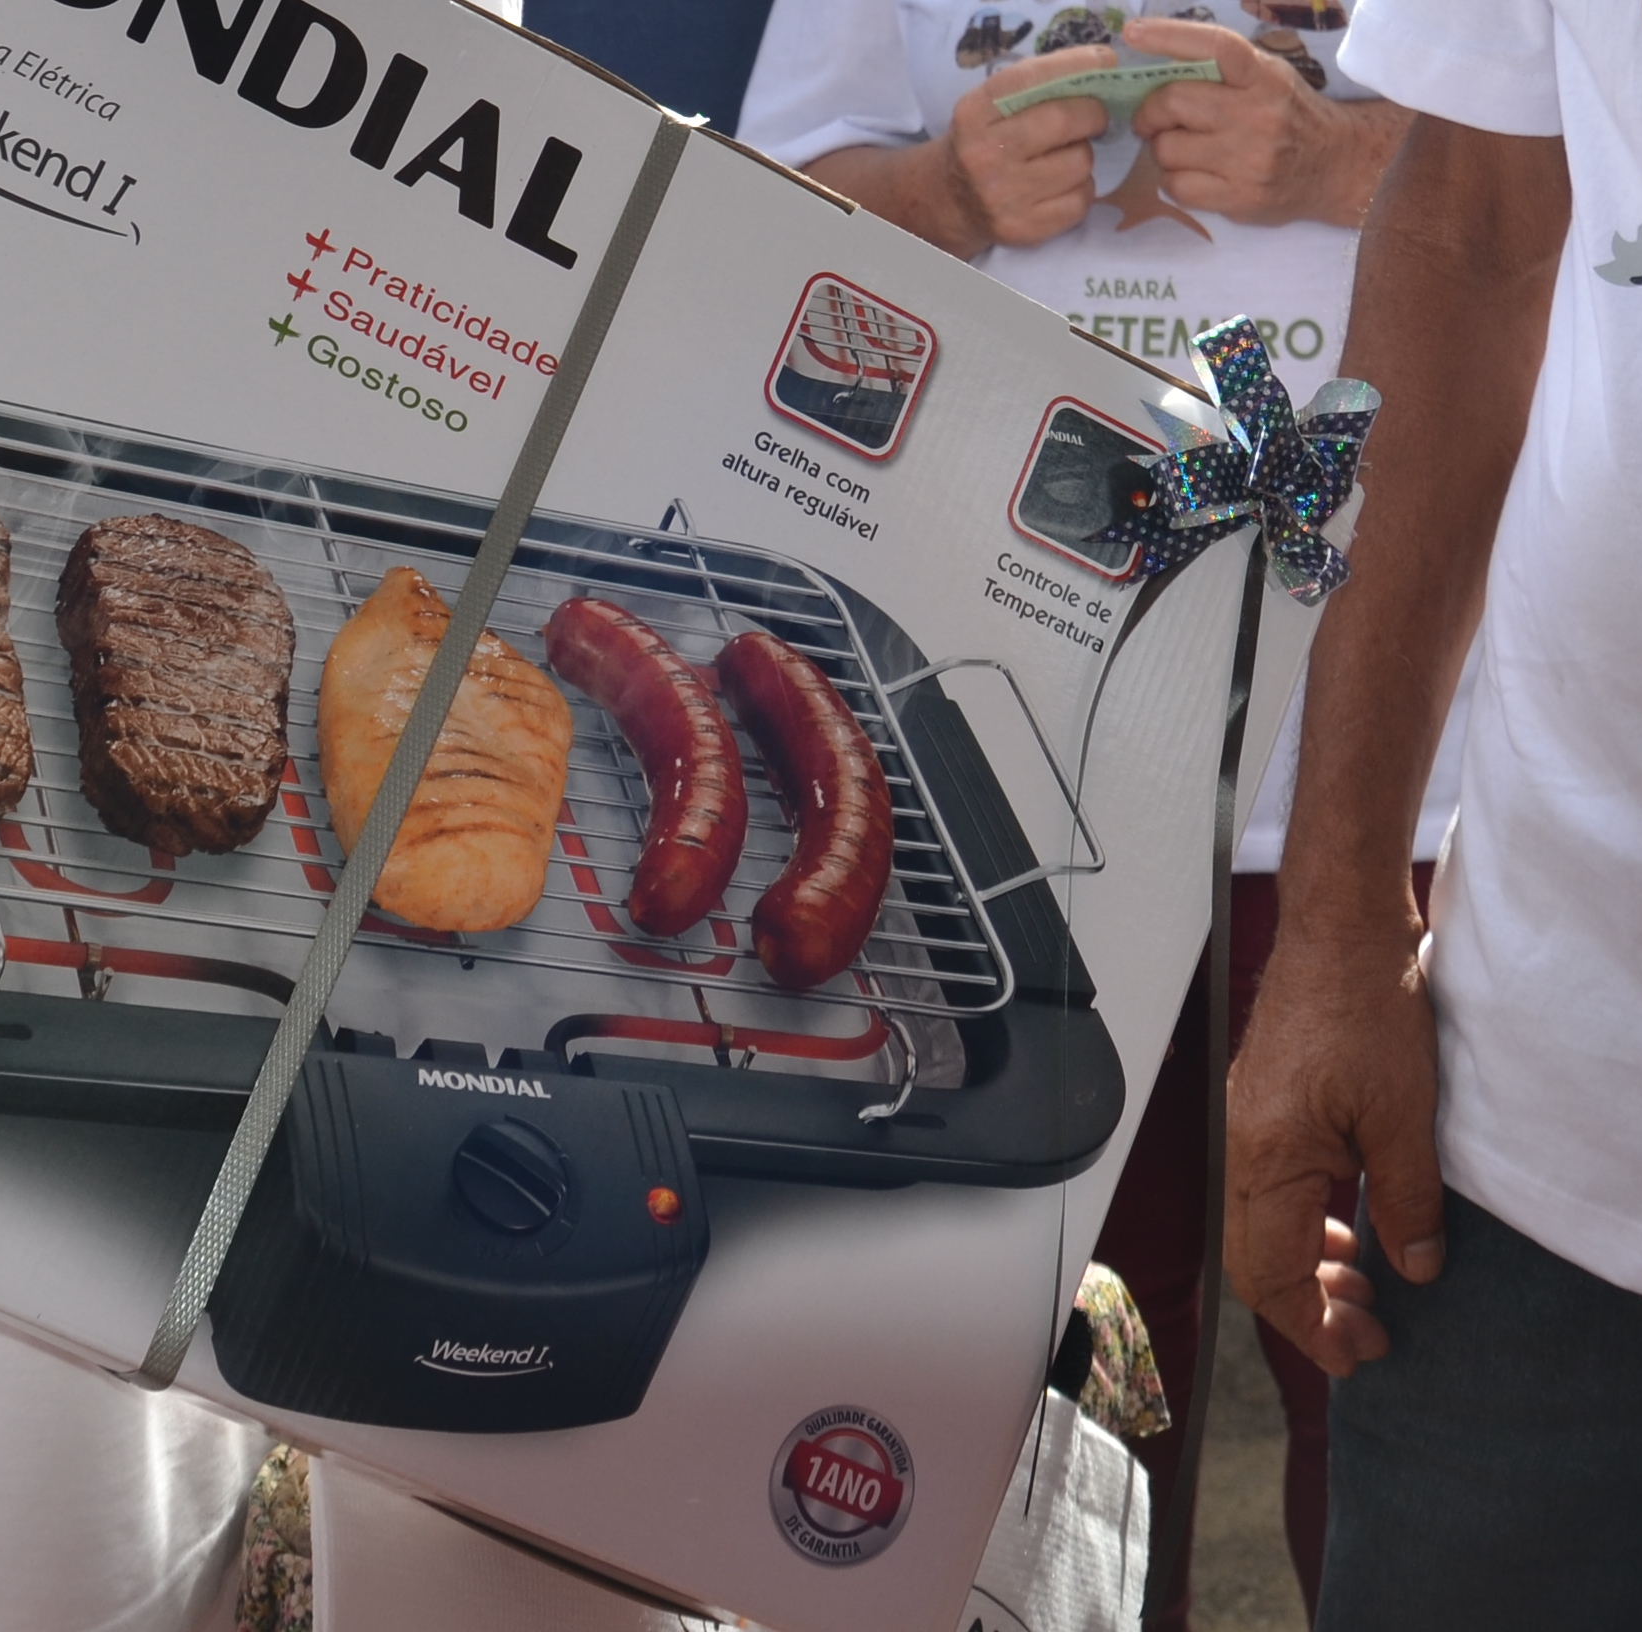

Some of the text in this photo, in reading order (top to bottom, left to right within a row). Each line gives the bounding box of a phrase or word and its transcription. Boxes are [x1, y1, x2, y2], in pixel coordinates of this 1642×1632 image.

[13, 50, 122, 123] Elétrica
[342, 247, 560, 376] Praticidade
[1084, 275, 1177, 301] SABARÁ
[323, 290, 507, 400] Saudável
[307, 334, 469, 433] Gostoso
[722, 453, 879, 542] altura regulável
[754, 431, 871, 504] Grelha com
[984, 577, 1105, 654] Temperatura
[997, 552, 1112, 624] Controle de
[418, 1069, 552, 1099] MONDIAL
[432, 1339, 534, 1365] Weekend
[805, 1411, 908, 1475] QUALIDADE GARANTIDA
[785, 1514, 862, 1558] DE GARANTIA
